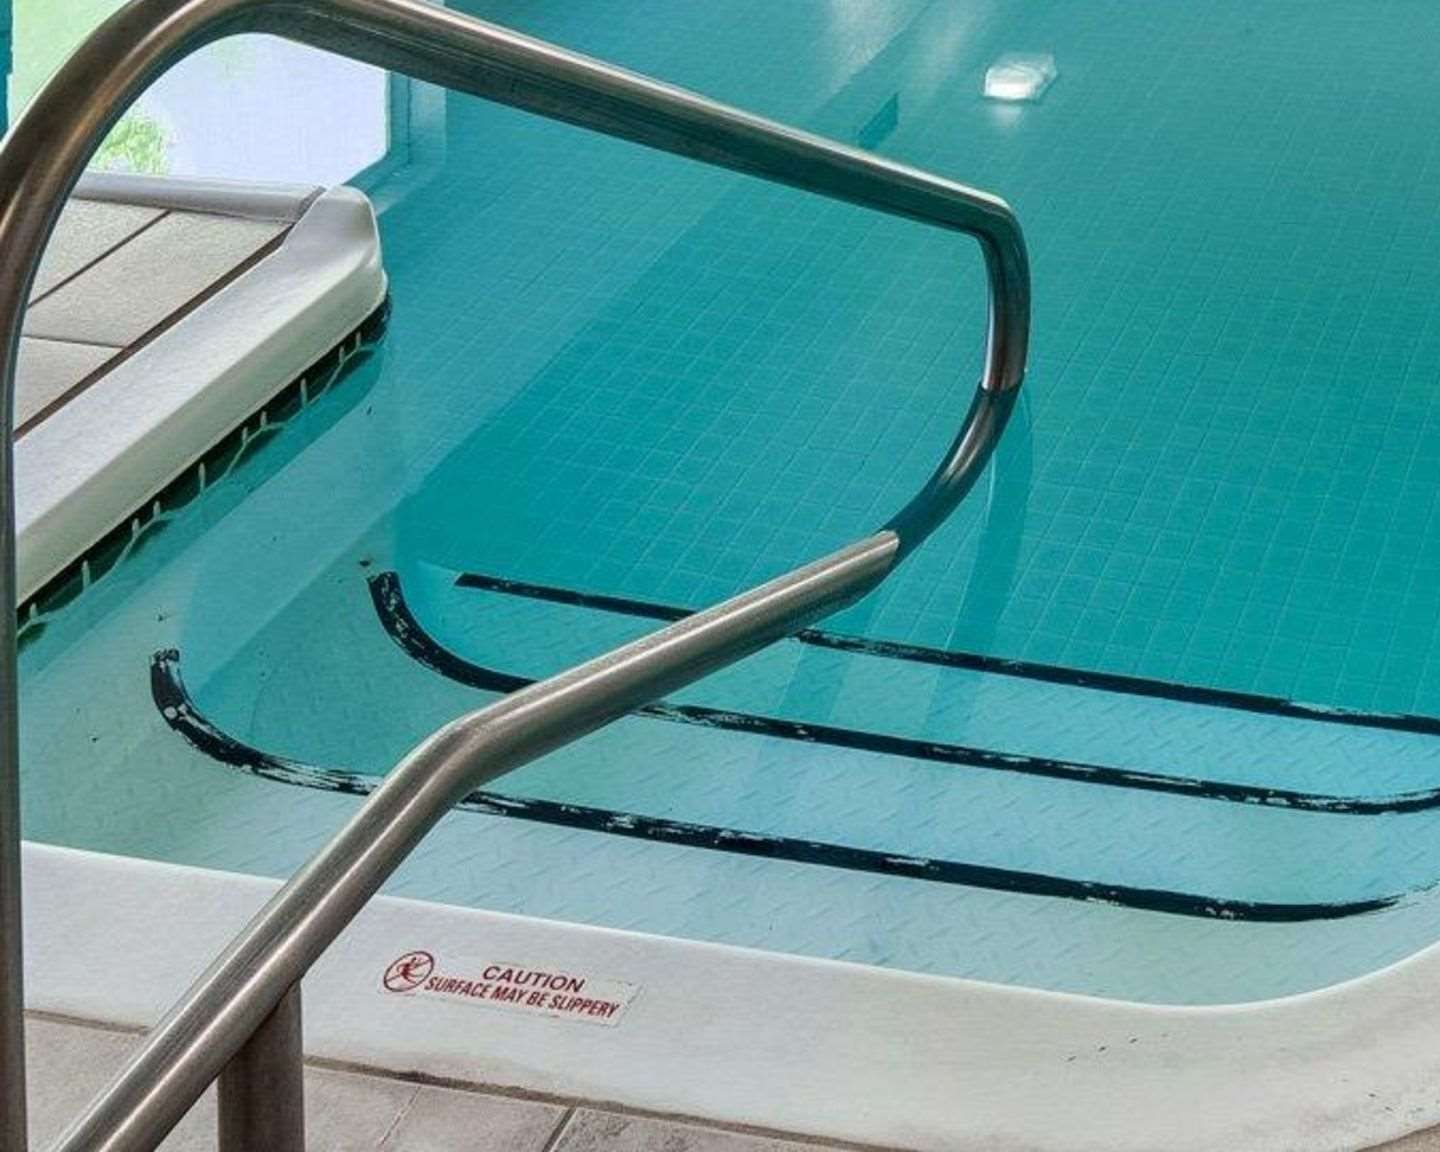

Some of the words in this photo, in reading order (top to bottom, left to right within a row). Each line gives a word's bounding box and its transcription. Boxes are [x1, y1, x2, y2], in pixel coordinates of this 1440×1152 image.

[424, 975, 493, 1000] SURFACE
[491, 985, 528, 1005] MAY
[527, 990, 547, 1008] BE
[548, 995, 621, 1019] SLIPPERY
[482, 965, 586, 993] CAUTION
